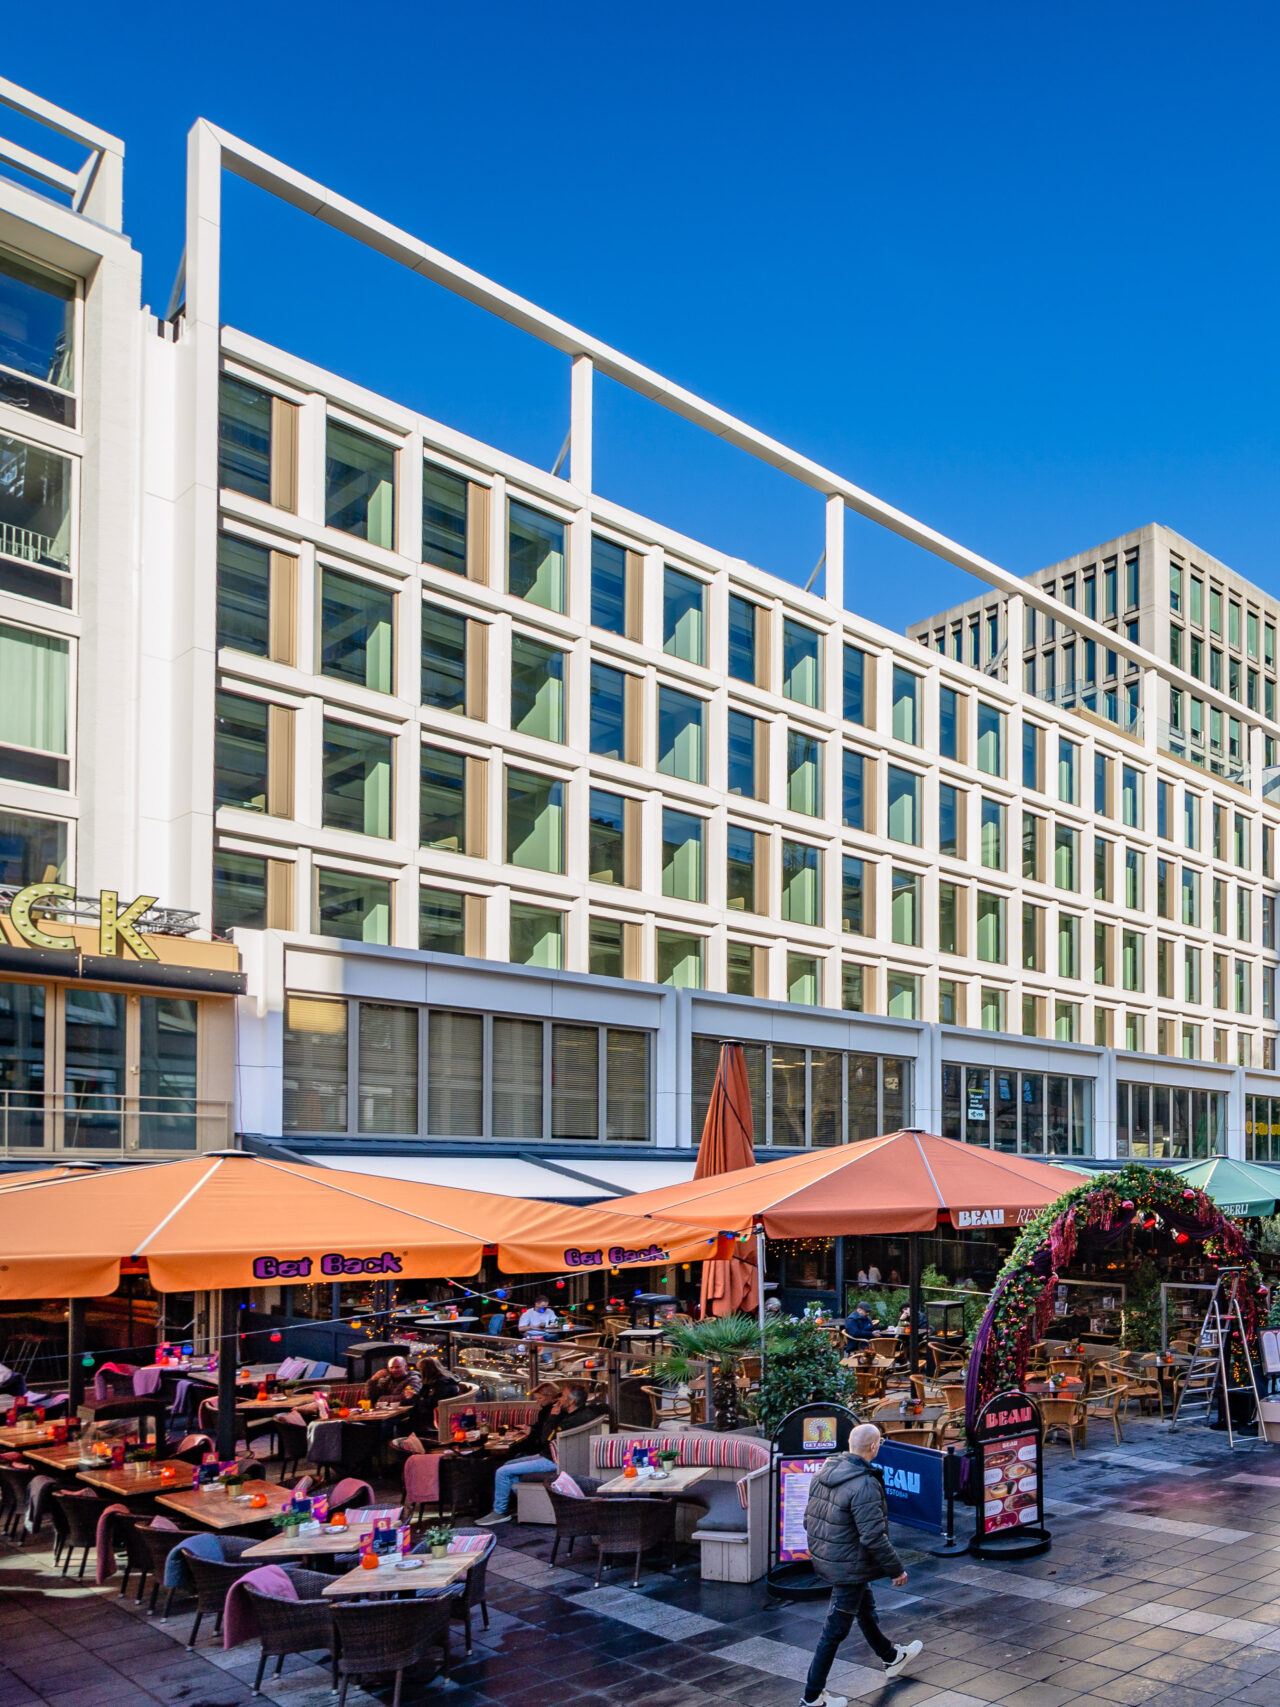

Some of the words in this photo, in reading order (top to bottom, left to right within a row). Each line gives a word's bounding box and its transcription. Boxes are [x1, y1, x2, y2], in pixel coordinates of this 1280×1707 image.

[0, 882, 160, 961] CK
[958, 1209, 1005, 1227] BEAU
[1016, 1208, 1047, 1224] REST
[253, 1256, 313, 1280] Get
[321, 1252, 403, 1275] Back
[564, 1248, 604, 1267] Get
[608, 1244, 666, 1264] Back
[985, 1406, 1033, 1429] BEAU
[803, 1462, 824, 1473] ME
[884, 1486, 909, 1499] ESTOBAR
